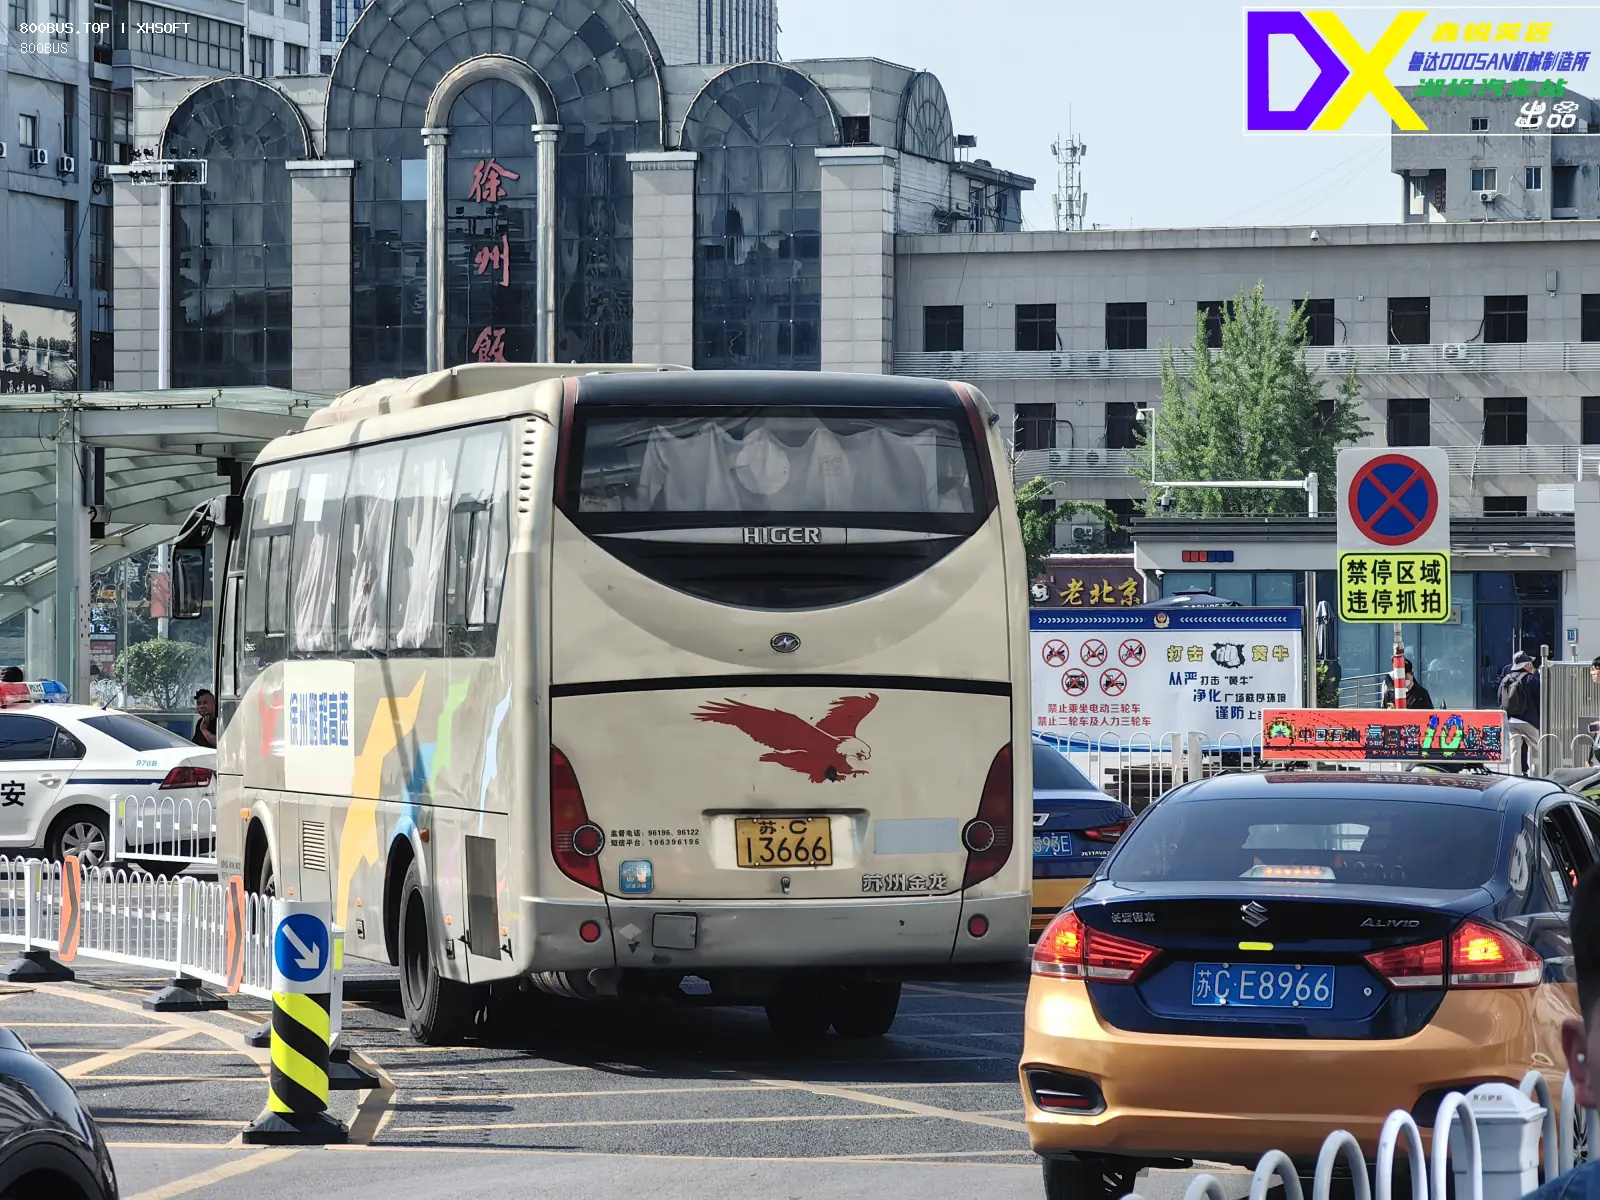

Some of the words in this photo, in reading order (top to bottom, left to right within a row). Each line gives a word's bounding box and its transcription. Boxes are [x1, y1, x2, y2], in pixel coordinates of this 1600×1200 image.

[742, 526, 822, 545] HIGER
[1346, 559, 1442, 586] 禁停区域
[1060, 577, 1141, 607] 老北京
[1346, 589, 1442, 615] 违停抓拍
[1167, 644, 1204, 663] 打击
[1251, 644, 1289, 663] 黄牛
[1168, 671, 1198, 686] 从严
[1193, 688, 1222, 703] 净化
[1224, 692, 1287, 703] 广场秩序环境
[1047, 703, 1141, 714] 禁止乘坐电动三轮车
[1215, 705, 1245, 720] 谨防
[1037, 716, 1152, 727] 禁止二轮车及人力三轮车
[135, 759, 158, 767] 976B
[0, 780, 26, 807] 安
[747, 836, 827, 863] 13666
[862, 873, 948, 893] 苏州金龙
[1360, 917, 1420, 928] ALIVIO
